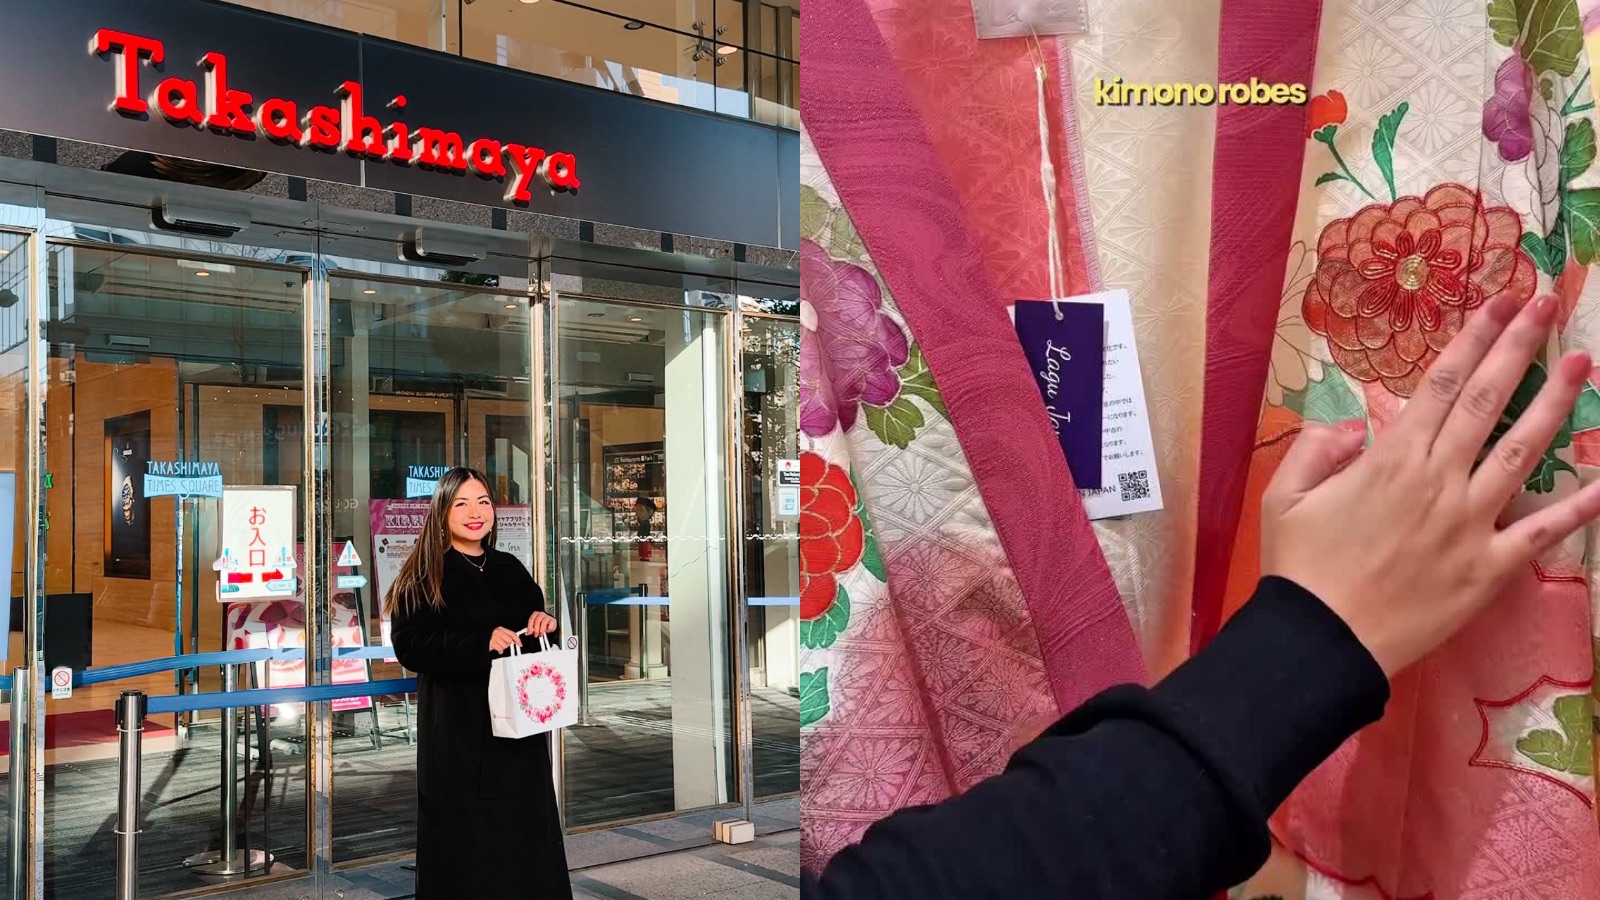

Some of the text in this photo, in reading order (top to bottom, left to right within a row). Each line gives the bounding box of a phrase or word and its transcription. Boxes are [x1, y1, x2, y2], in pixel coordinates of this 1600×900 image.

[90, 28, 580, 202] Takashimaya
[1040, 339, 1071, 399] Lagu
[147, 461, 220, 475] TAKASHIMAYA
[147, 479, 220, 499] TIMES SQUARE
[408, 481, 432, 494] TIMES
[1088, 485, 1117, 497] JAPAN
[249, 506, 267, 567] お入口
